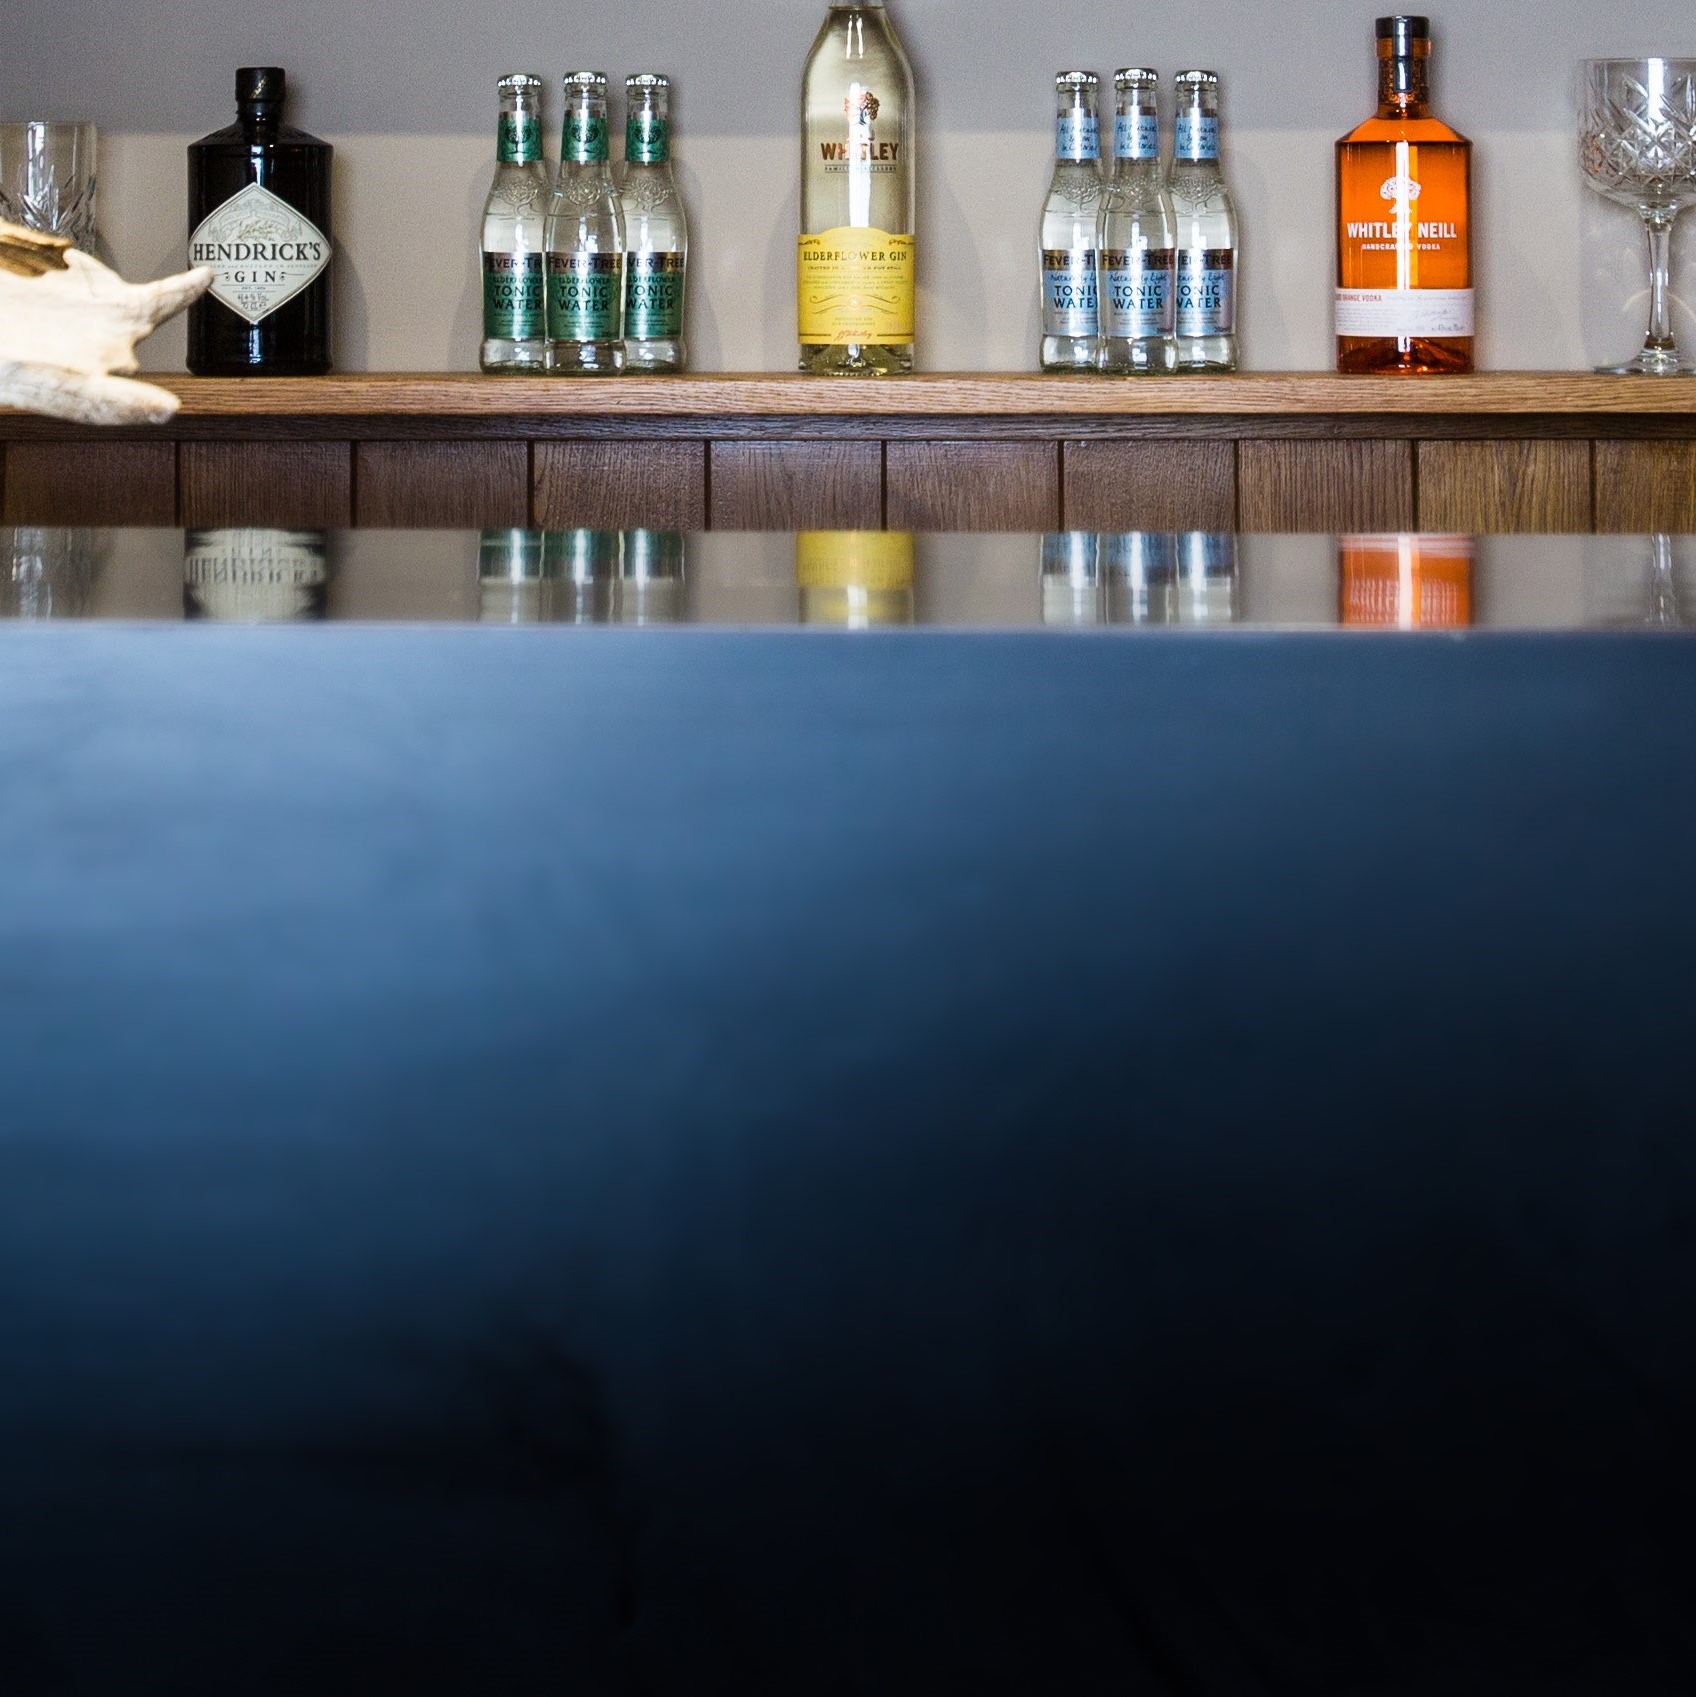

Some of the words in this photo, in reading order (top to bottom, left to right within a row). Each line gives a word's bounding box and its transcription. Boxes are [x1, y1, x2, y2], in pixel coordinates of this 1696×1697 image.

[821, 143, 899, 160] WHTLEY
[1418, 222, 1457, 239] NEILL
[193, 242, 321, 261] HENDRICK'S
[803, 251, 886, 261] ELDERFLOWER
[889, 251, 907, 261] GIN
[550, 257, 621, 269] FEVER-TREE
[628, 257, 684, 268] VER-TREE
[1043, 254, 1096, 266] FEVE-T
[234, 271, 276, 282] GIN
[493, 286, 541, 297] TONIC
[560, 286, 608, 297] TONIC
[628, 285, 673, 296] TONIC
[1114, 286, 1162, 297] TONIC
[1177, 285, 1220, 296] ONIC
[627, 298, 674, 309] WATER
[1054, 298, 1097, 309] WATE
[1113, 298, 1163, 309] WATER
[1363, 294, 1382, 302] VODKA
[493, 299, 542, 310] WATER
[559, 300, 610, 311] WATER
